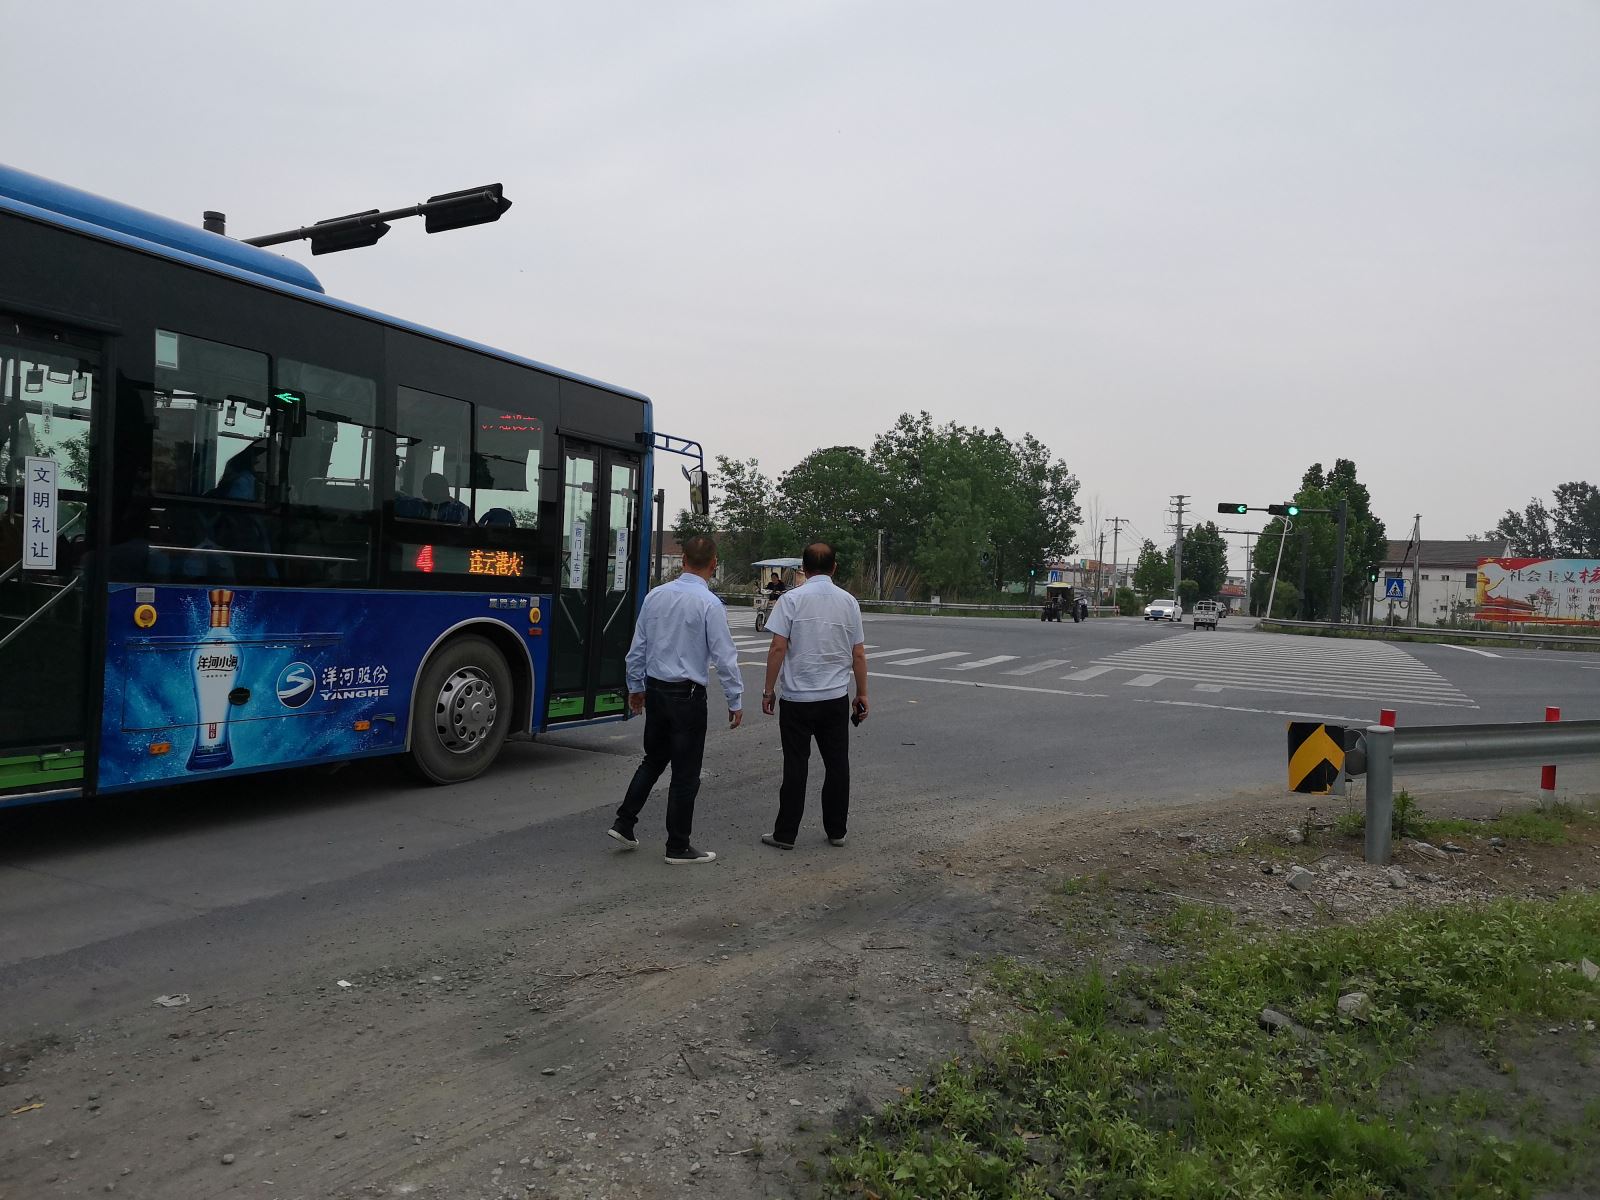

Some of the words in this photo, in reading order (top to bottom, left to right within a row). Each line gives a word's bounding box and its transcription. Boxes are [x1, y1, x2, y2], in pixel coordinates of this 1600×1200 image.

[31, 467, 50, 559] 文明礼让
[321, 665, 389, 690] 洋河股份
[320, 689, 389, 701] YANGHE
